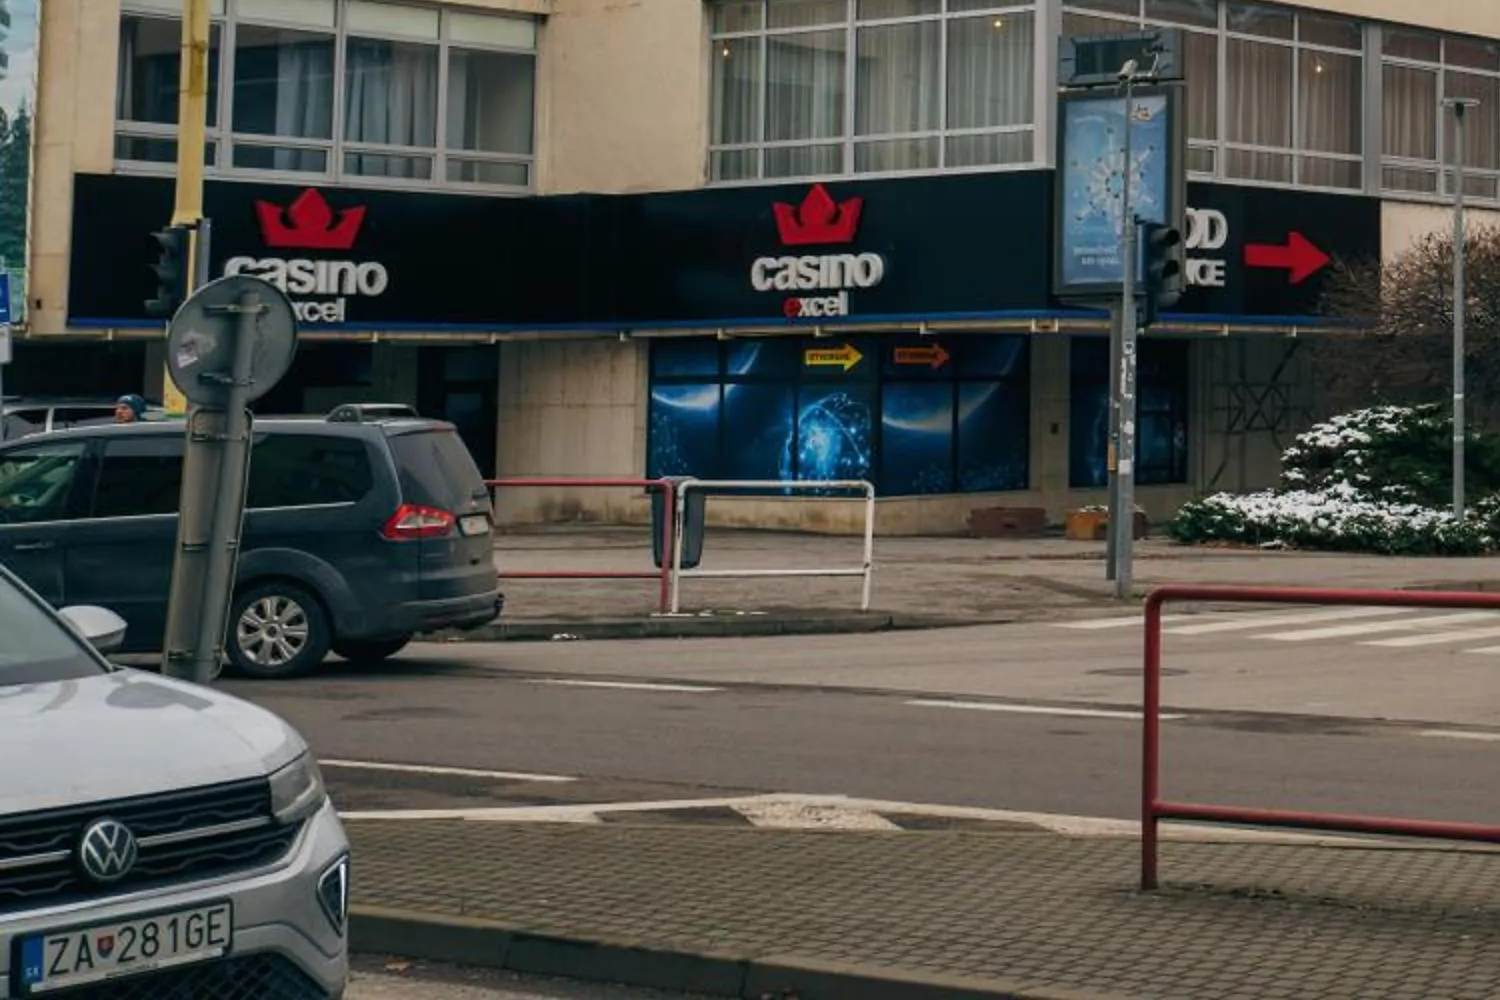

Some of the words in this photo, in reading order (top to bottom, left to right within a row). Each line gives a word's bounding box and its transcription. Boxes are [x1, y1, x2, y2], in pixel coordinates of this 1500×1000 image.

[224, 256, 389, 296] casino
[751, 252, 884, 291] casino
[292, 298, 346, 322] xcel
[783, 290, 848, 317] excel
[48, 934, 94, 977] ZA
[116, 908, 225, 963] 281GE
